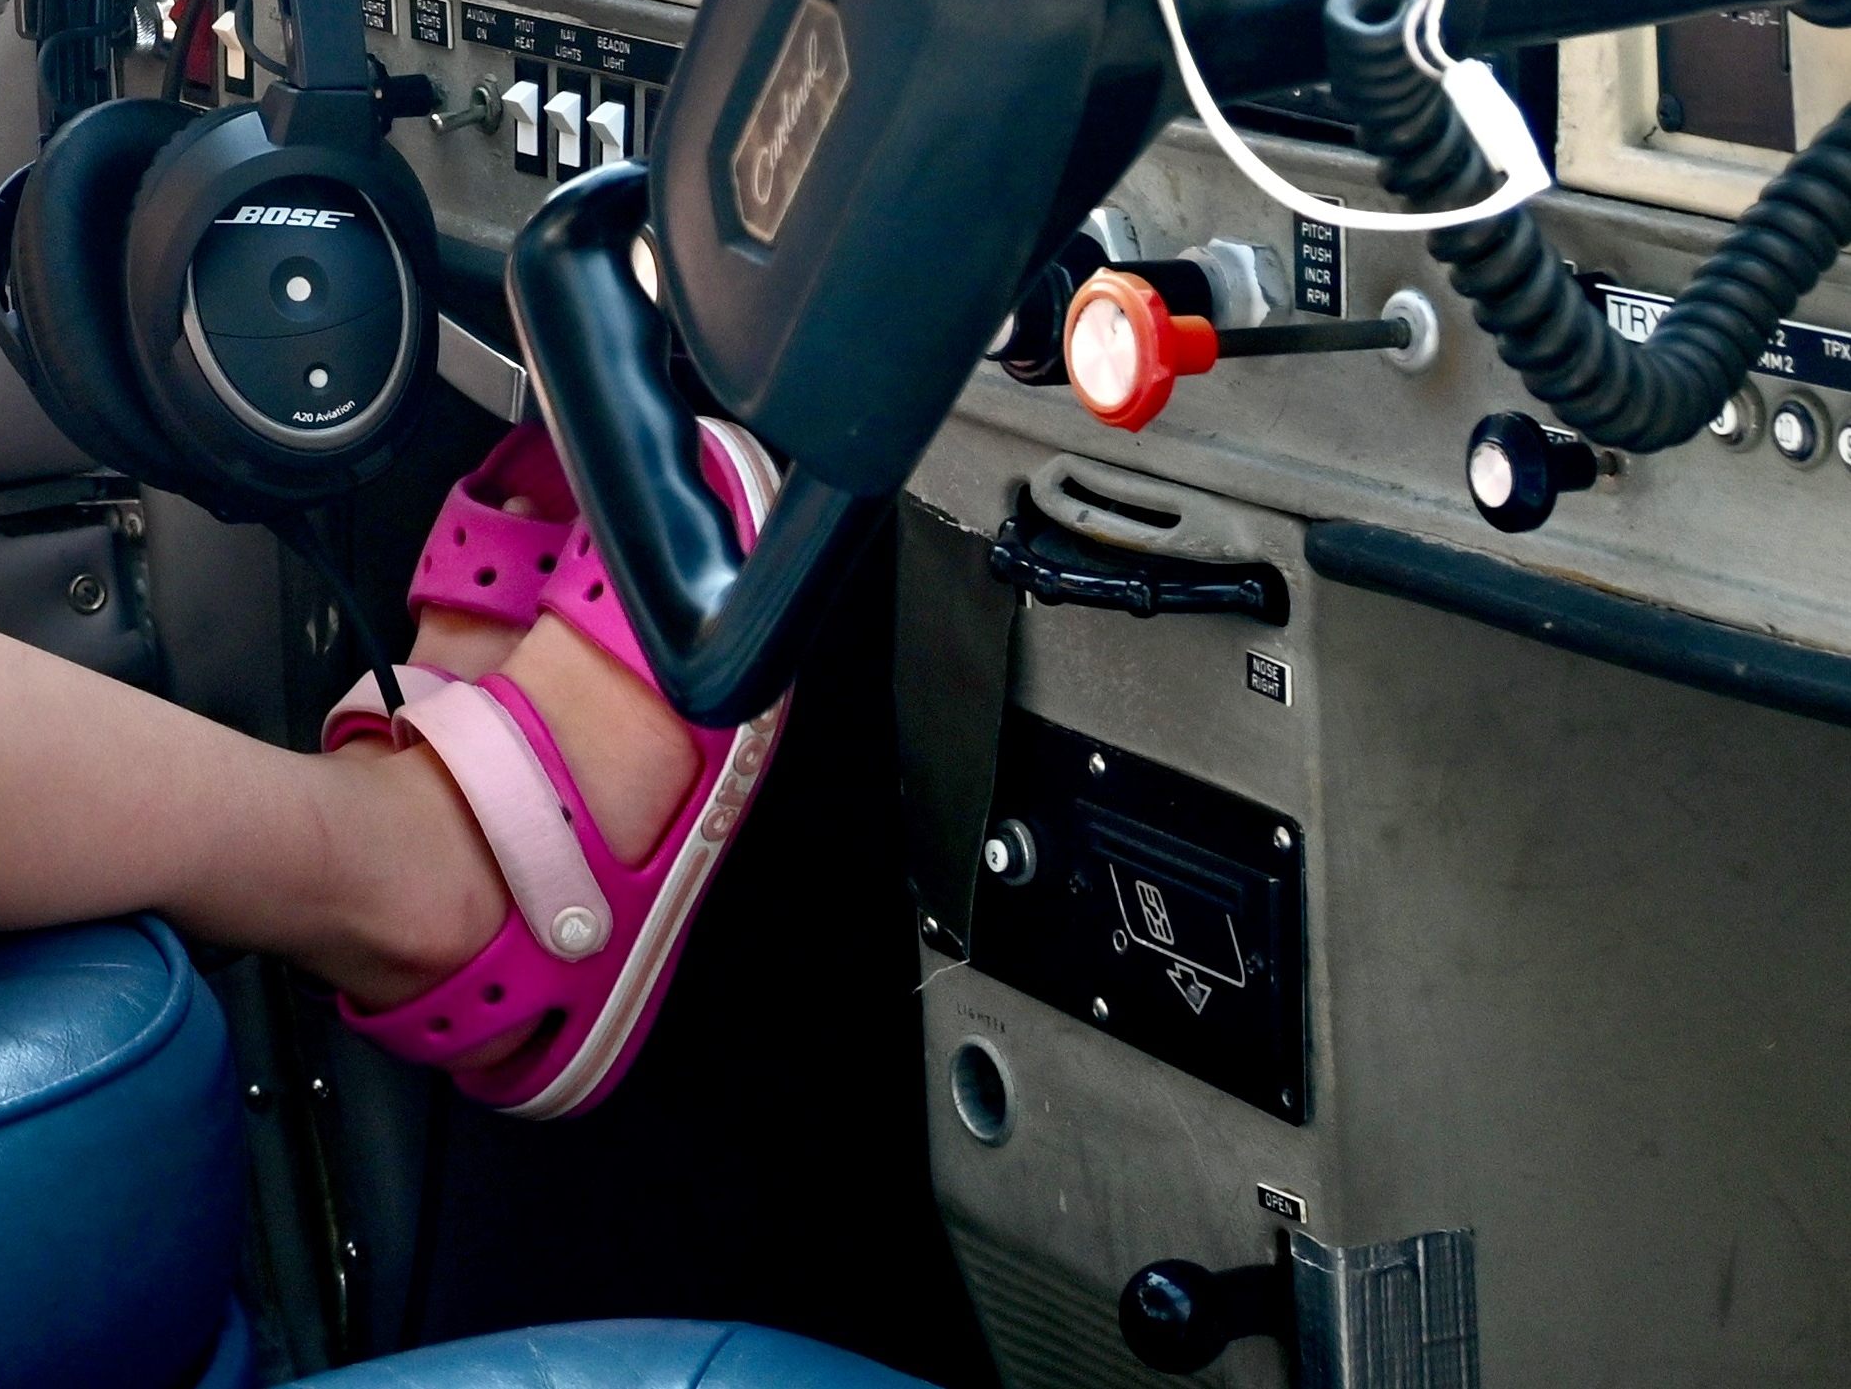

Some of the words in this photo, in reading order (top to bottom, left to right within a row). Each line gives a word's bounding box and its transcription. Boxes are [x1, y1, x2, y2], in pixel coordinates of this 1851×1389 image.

[362, 0, 386, 15] LIGHTS
[364, 13, 384, 29] TURN
[416, 12, 441, 29] LIGHTS
[466, 8, 497, 26] AVIONIK
[515, 17, 535, 34] PITOT
[419, 26, 439, 42] TURN
[476, 26, 488, 40] ON
[560, 28, 577, 43] NAV
[515, 35, 536, 51] HEAT
[597, 35, 631, 55] BEACON
[555, 44, 582, 62] LIGHTS
[602, 54, 626, 71] LIGHT
[753, 29, 828, 206] Cardinal
[214, 205, 356, 230] BOSE
[1301, 221, 1333, 241] PITCH
[1302, 243, 1333, 264] PUSH
[1304, 266, 1331, 285] INCR
[1306, 287, 1330, 307] RPM
[292, 410, 314, 423] A20
[315, 398, 356, 423] Aviation
[1252, 657, 1279, 681] NOSE
[1252, 672, 1279, 697] RIGHT
[991, 851, 998, 865] 2
[1265, 1192, 1293, 1215] OPEN
